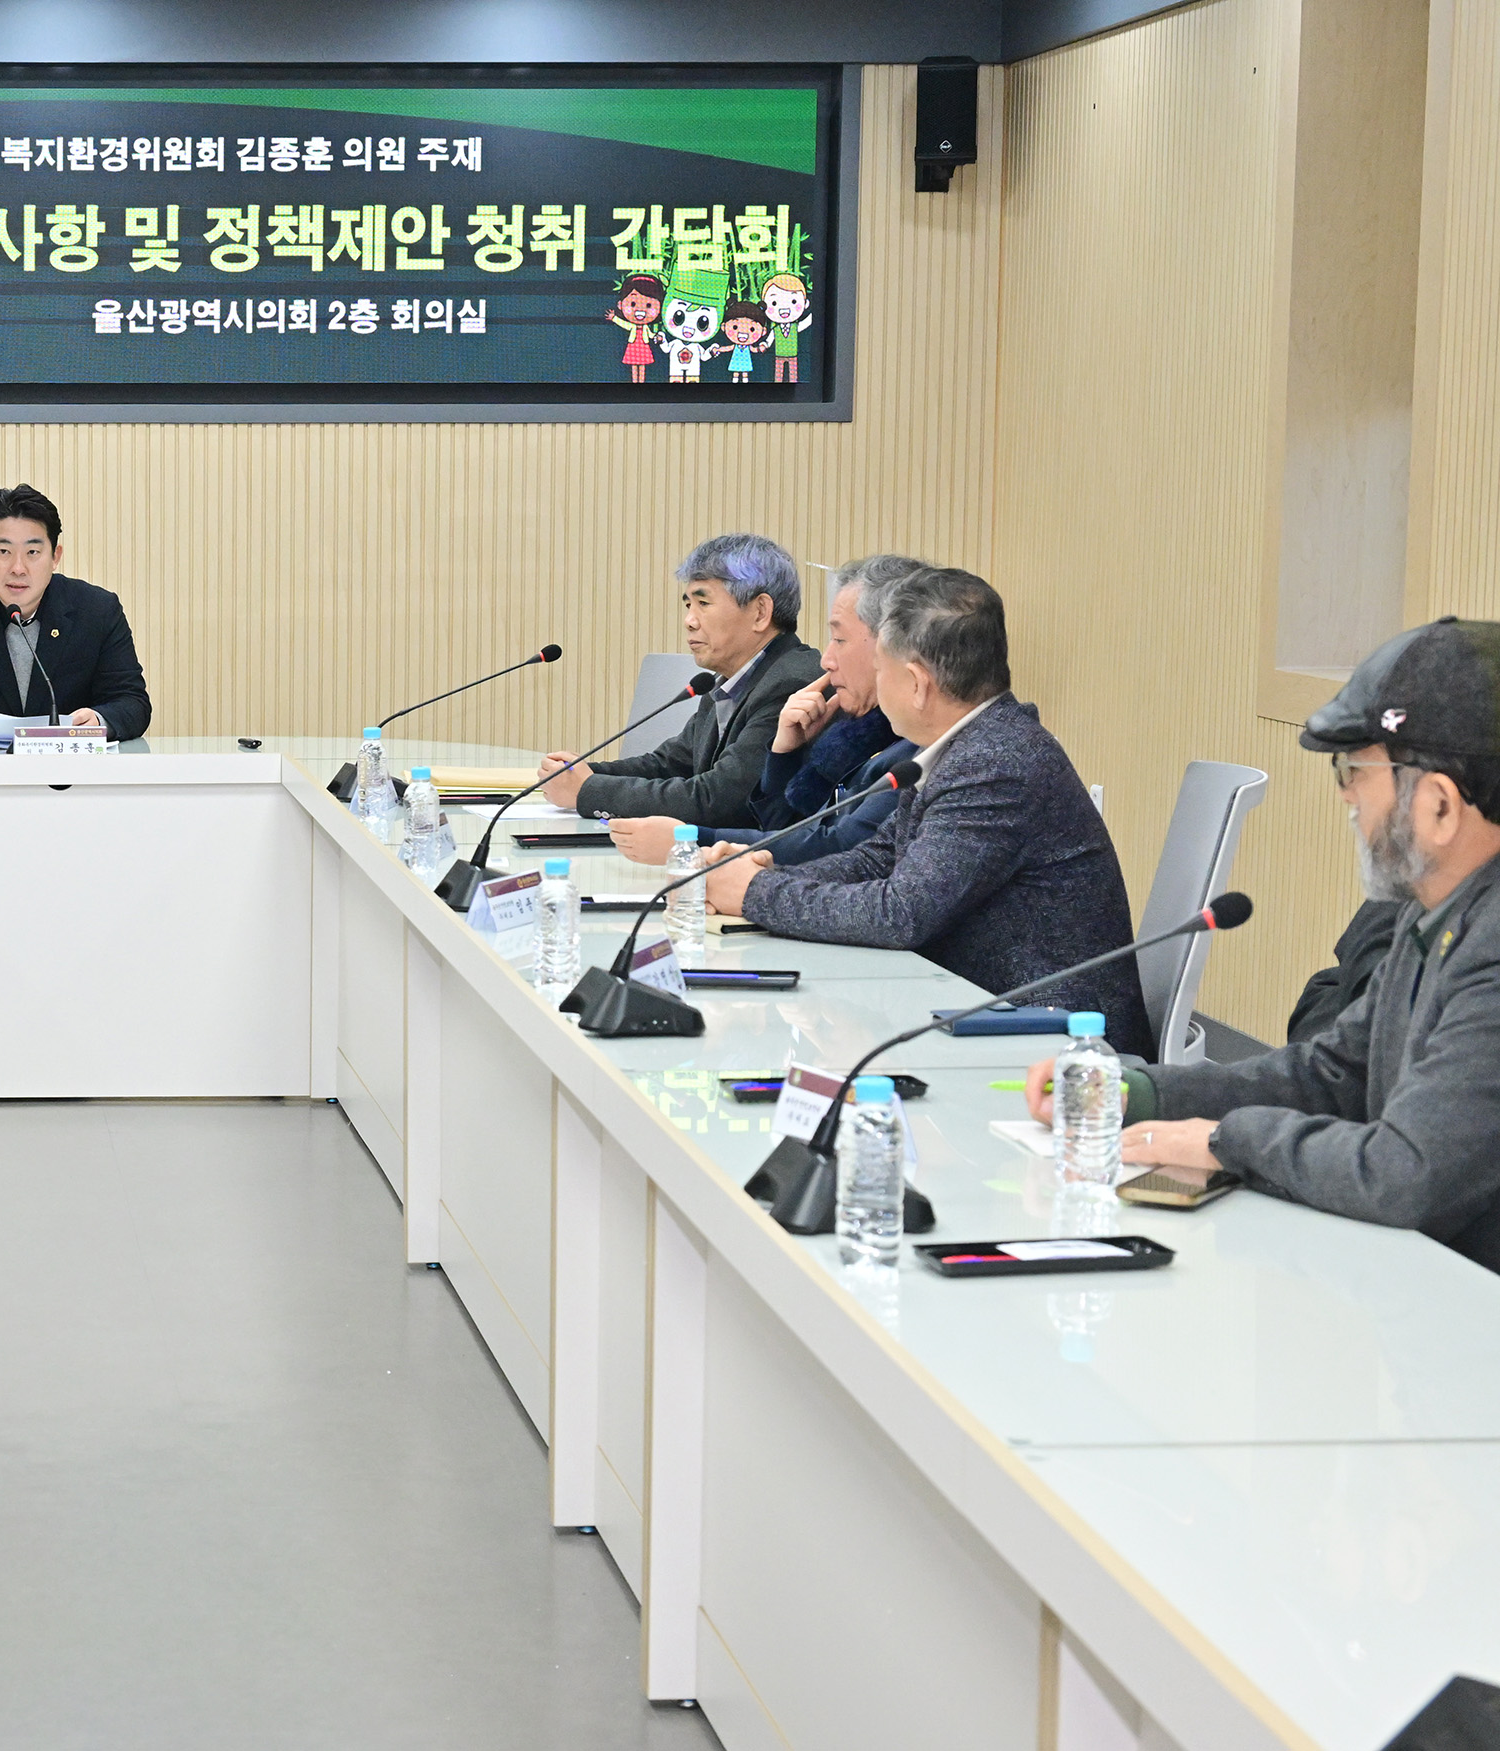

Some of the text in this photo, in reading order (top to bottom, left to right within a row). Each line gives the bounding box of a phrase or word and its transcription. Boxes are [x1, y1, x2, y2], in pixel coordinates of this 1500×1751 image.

[236, 136, 334, 172] 김종훈
[342, 136, 406, 172] 의원
[417, 136, 482, 172] 주재
[125, 204, 182, 273] 및
[202, 204, 451, 273] 정책제안
[466, 204, 587, 273] 청취
[610, 204, 790, 273] 간담회
[91, 298, 487, 335] 울산광역시의회 2층 회의실
